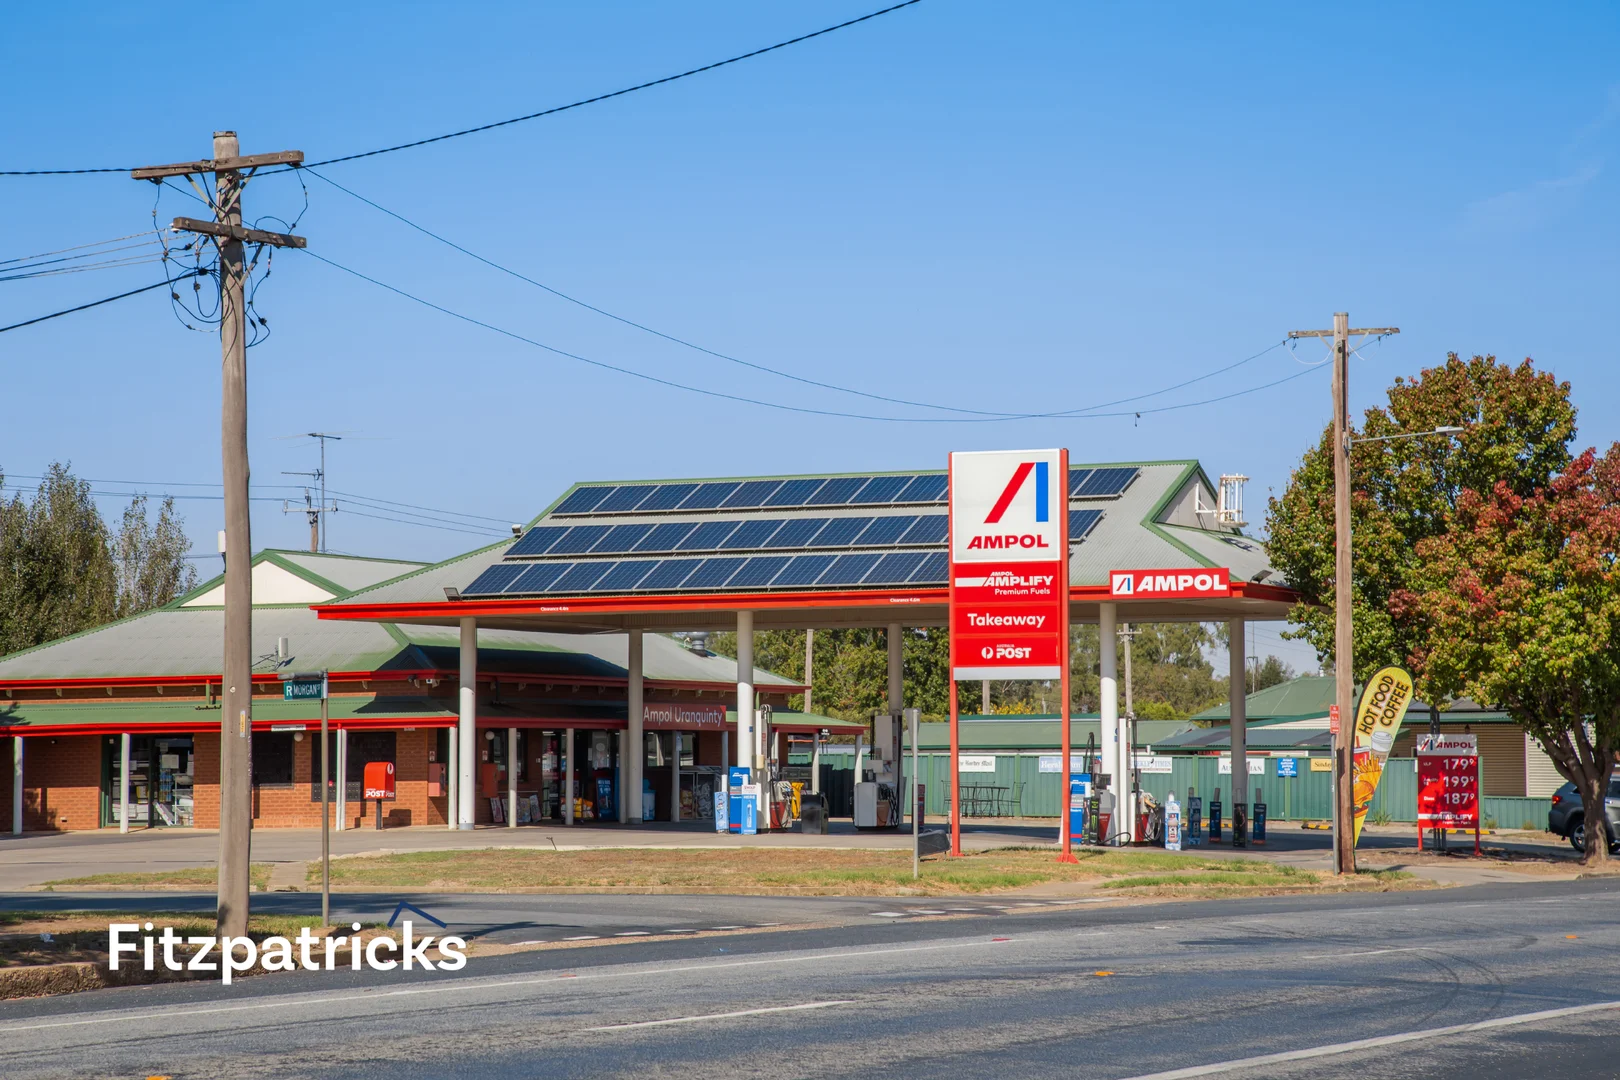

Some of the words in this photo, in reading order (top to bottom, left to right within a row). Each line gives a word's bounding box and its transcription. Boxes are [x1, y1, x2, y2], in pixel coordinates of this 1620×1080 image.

[967, 534, 1049, 550] AMPOL
[983, 576, 1054, 587] AMPLIFY
[1136, 574, 1227, 592] AMPOL
[994, 588, 1029, 596] Premium
[1030, 587, 1051, 595] Fuels
[967, 612, 1046, 628] Takeaway
[996, 648, 1032, 659] POST
[293, 684, 317, 696] MORGAN
[1358, 708, 1378, 735] HOT
[1370, 675, 1394, 709] FOOD
[1380, 681, 1410, 727] COFFEE
[643, 706, 672, 726] Ampol
[674, 707, 723, 728] Uranquinty
[1436, 741, 1474, 749] AMPOL
[366, 790, 386, 798] POST
